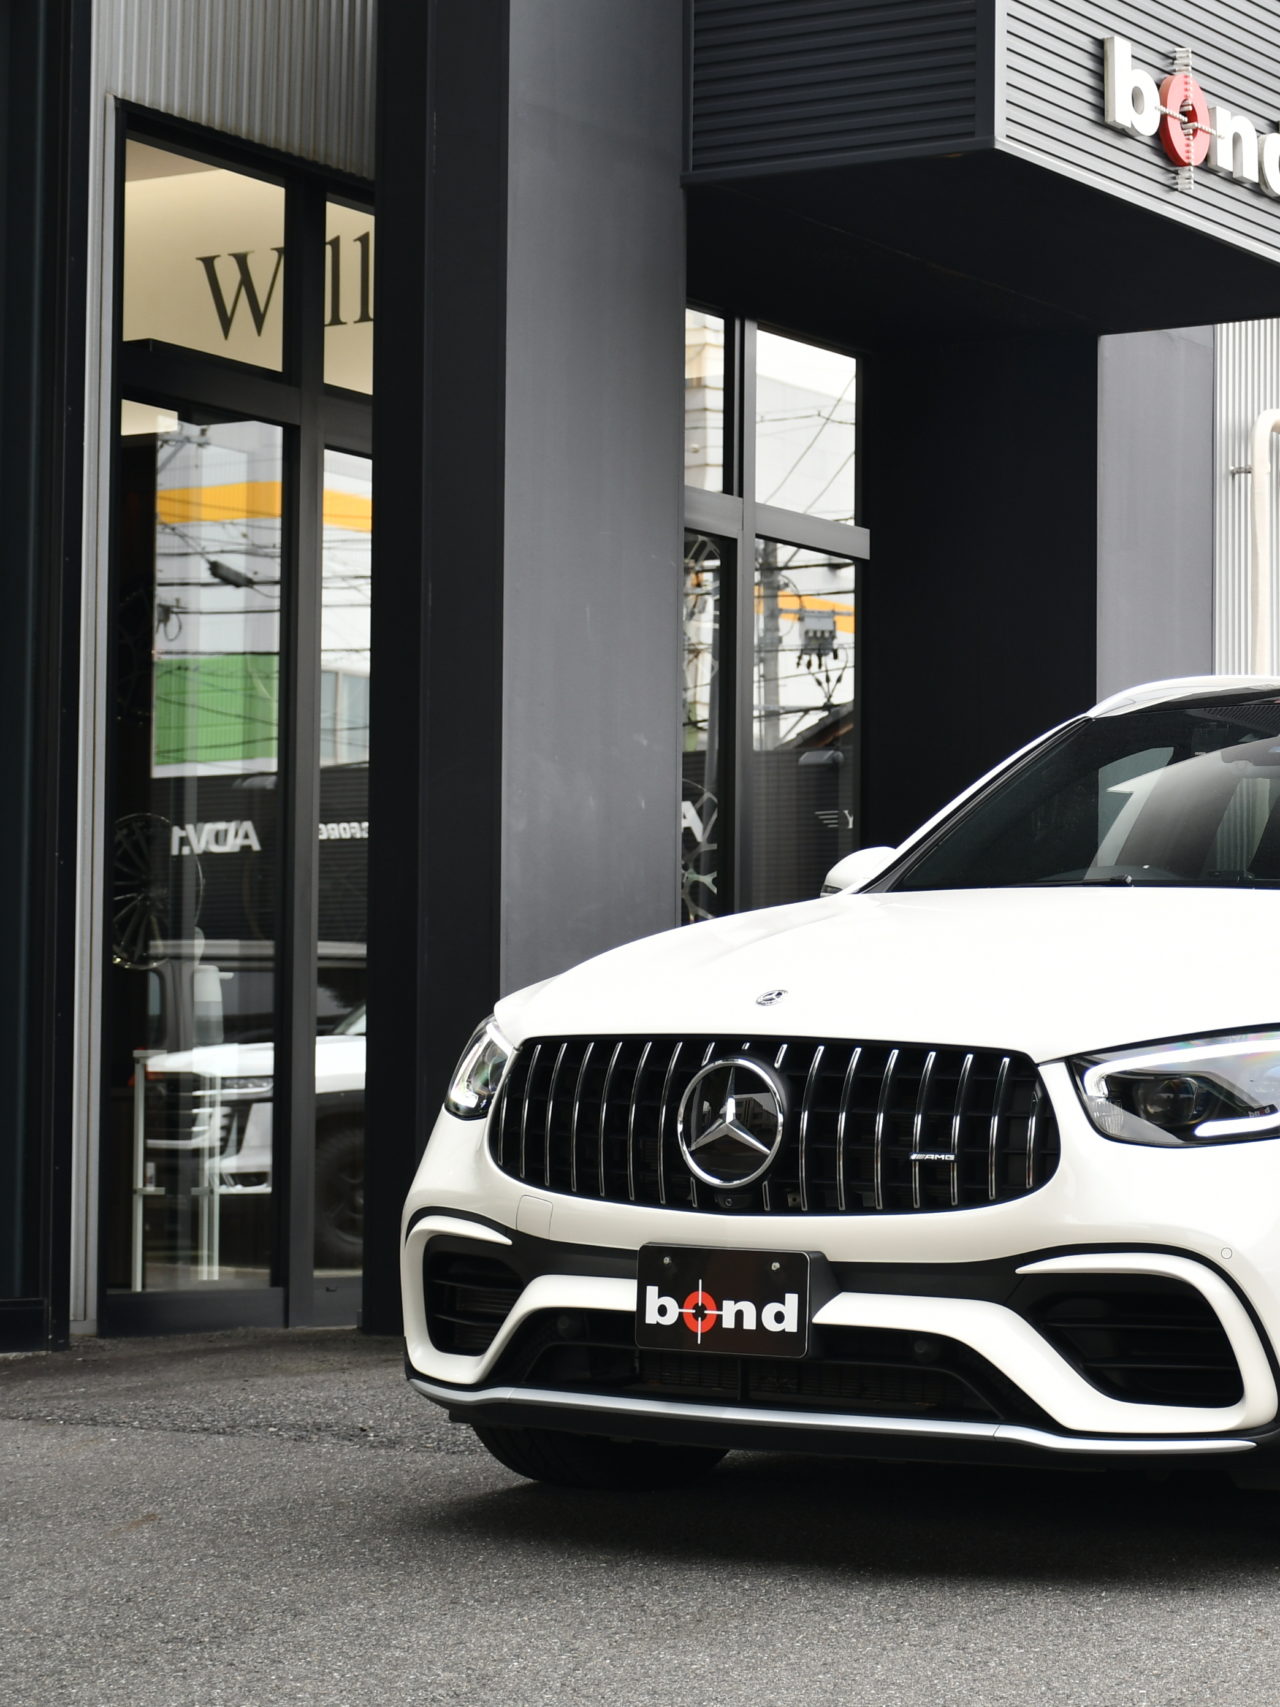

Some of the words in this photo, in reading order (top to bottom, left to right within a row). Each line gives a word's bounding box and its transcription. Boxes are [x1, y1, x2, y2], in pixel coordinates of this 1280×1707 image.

[195, 231, 374, 341] Wll
[922, 1153, 955, 1161] AMG
[645, 1285, 799, 1334] bond
